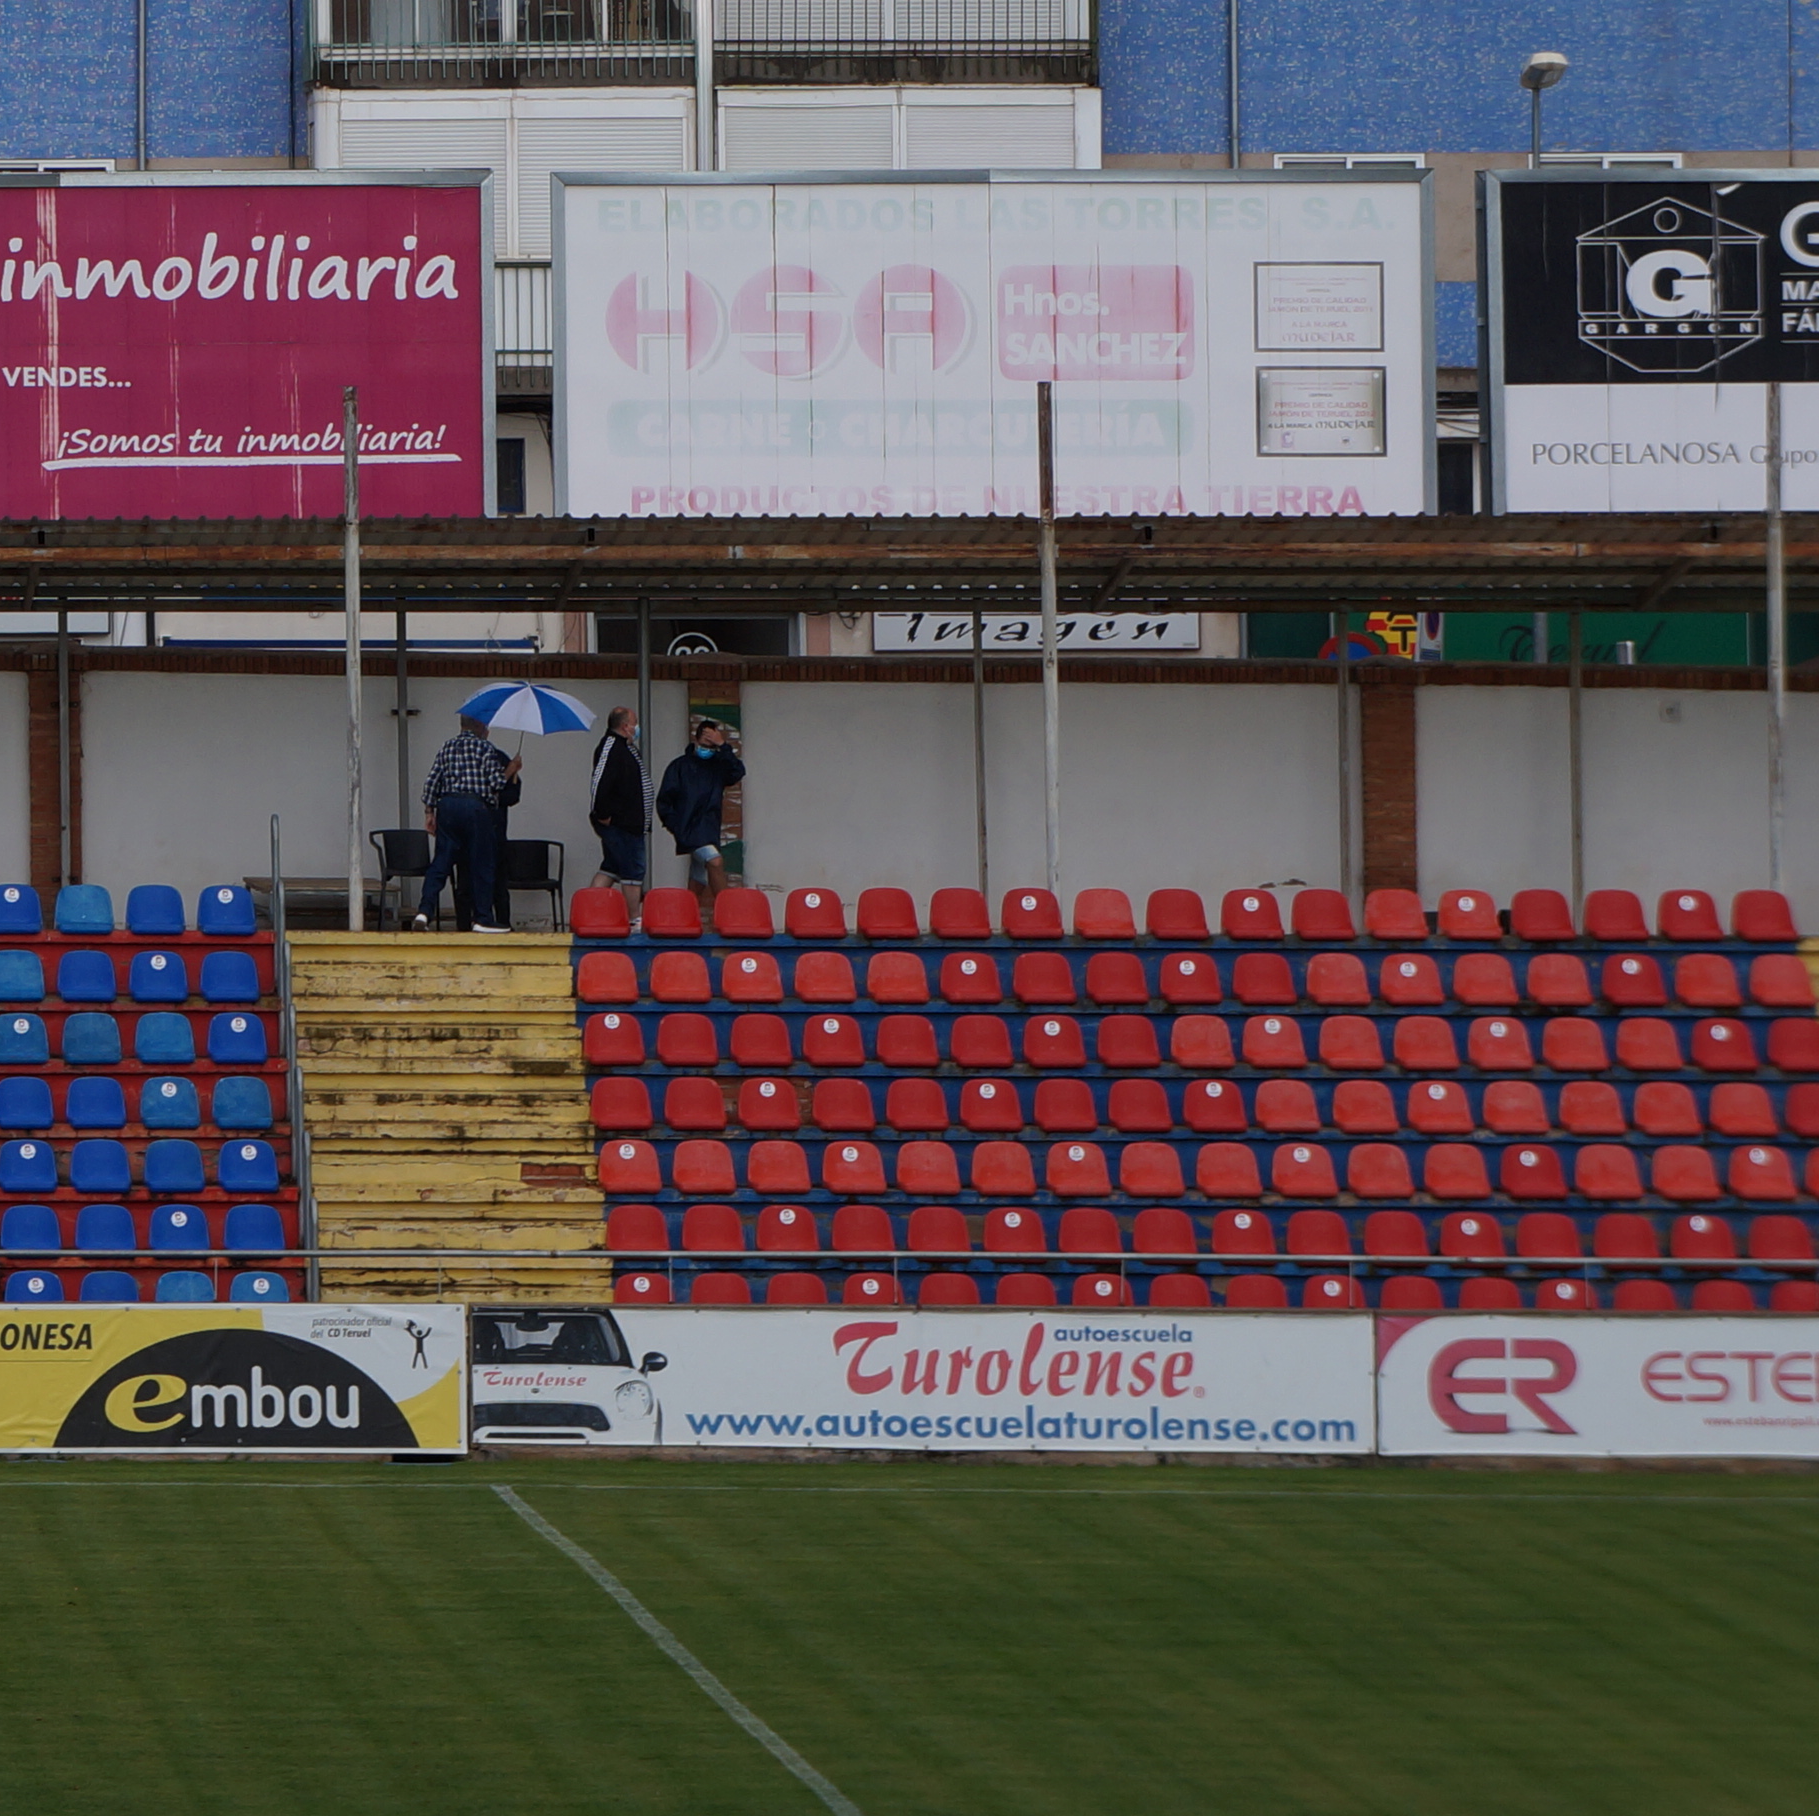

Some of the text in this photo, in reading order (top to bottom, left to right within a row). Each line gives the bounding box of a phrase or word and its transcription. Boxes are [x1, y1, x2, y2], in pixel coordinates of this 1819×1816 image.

[597, 195, 1267, 234] ELABORADOS LAS TORRES
[0, 232, 459, 301] inmobiliaria
[1003, 282, 1108, 318] Hnos.
[605, 263, 976, 379] HSA
[1584, 322, 1753, 334] GARGON
[1003, 331, 1188, 367] SANCHEZ
[57, 428, 223, 458] ¡Somos tu
[1531, 442, 1741, 465] PORCELANOSA
[630, 485, 1365, 515] PRODUCTOS NUESTRA TIERRA
[327, 1328, 340, 1338] CD
[341, 1328, 371, 1338] Teruel
[1054, 1323, 1193, 1343] autoescuela
[833, 1321, 1194, 1398] Turolense
[483, 1369, 588, 1388] Turolense
[105, 1365, 360, 1433] embou
[685, 1404, 1357, 1442] www.autoescuelaturolense.com
